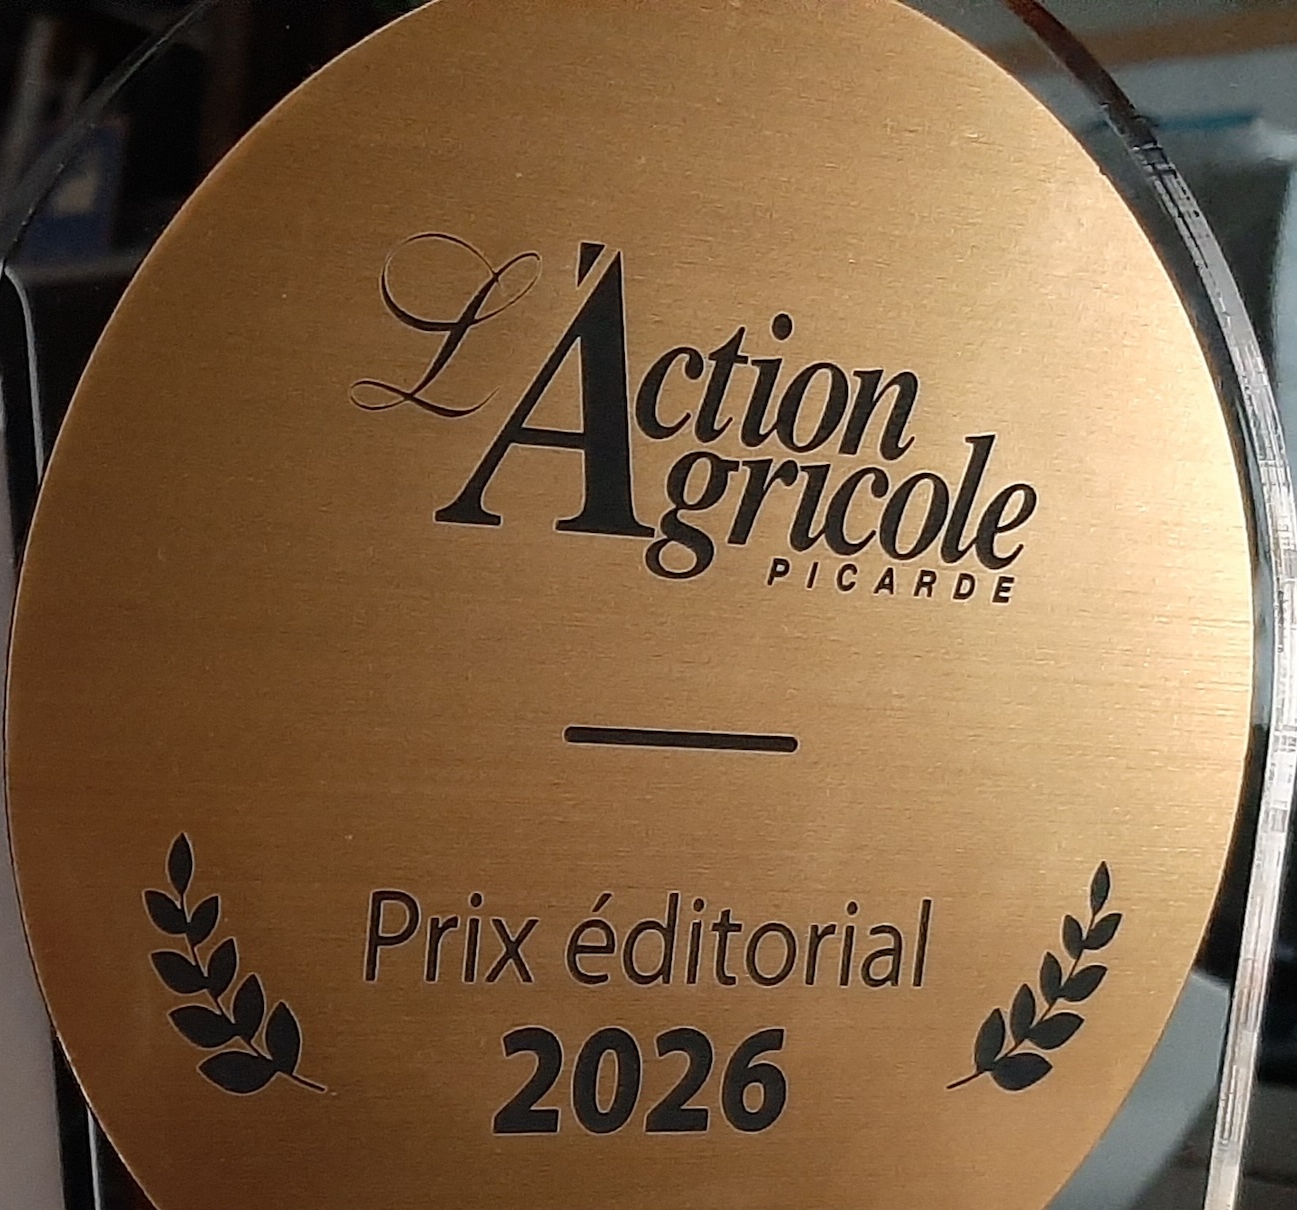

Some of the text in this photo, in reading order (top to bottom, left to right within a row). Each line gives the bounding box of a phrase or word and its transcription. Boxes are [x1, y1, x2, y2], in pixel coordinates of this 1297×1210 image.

[767, 556, 1018, 605] PICARDE
[363, 889, 932, 988] Prix éditorial
[492, 1025, 788, 1135] 2026
